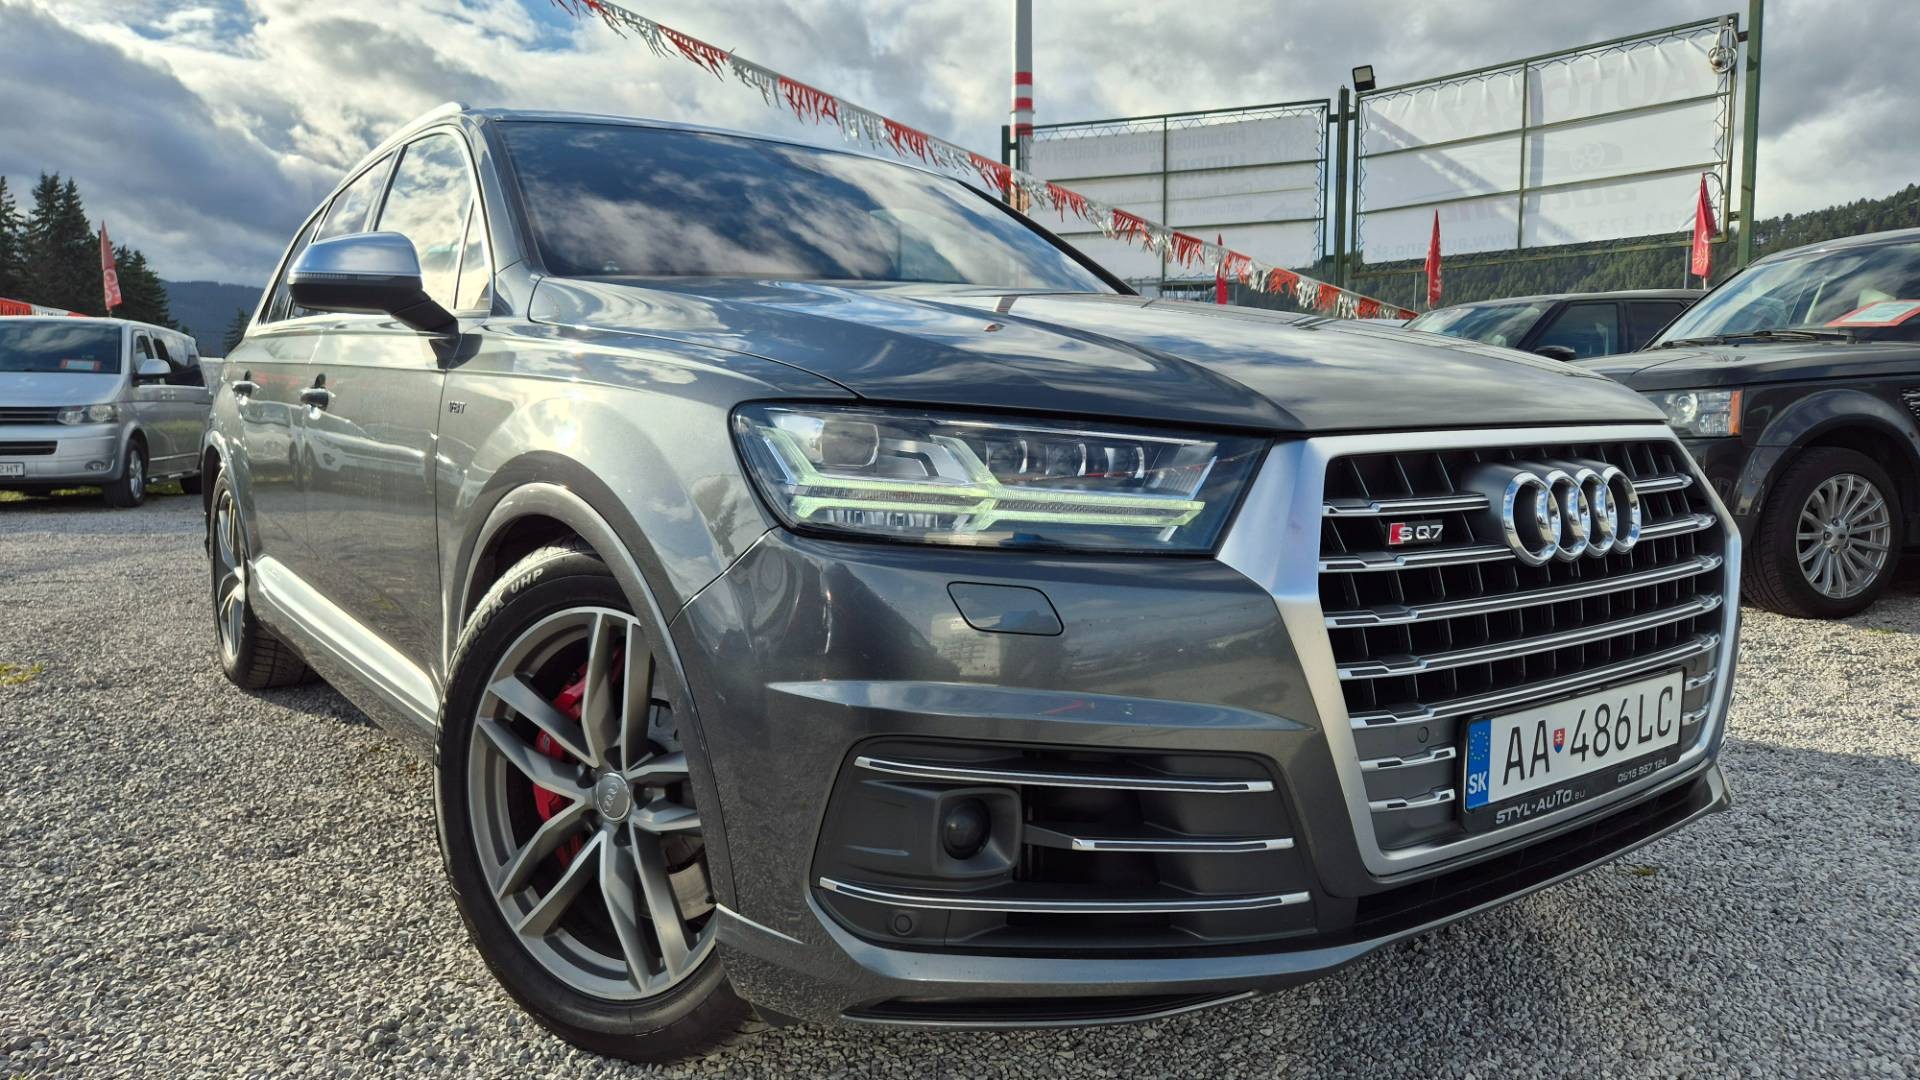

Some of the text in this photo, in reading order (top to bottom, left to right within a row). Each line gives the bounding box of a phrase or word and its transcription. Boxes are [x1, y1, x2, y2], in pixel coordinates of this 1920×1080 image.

[1398, 524, 1443, 541] SQ7
[511, 567, 544, 593] UHP
[1503, 686, 1673, 786] AA 486LC
[1468, 769, 1488, 796] SK
